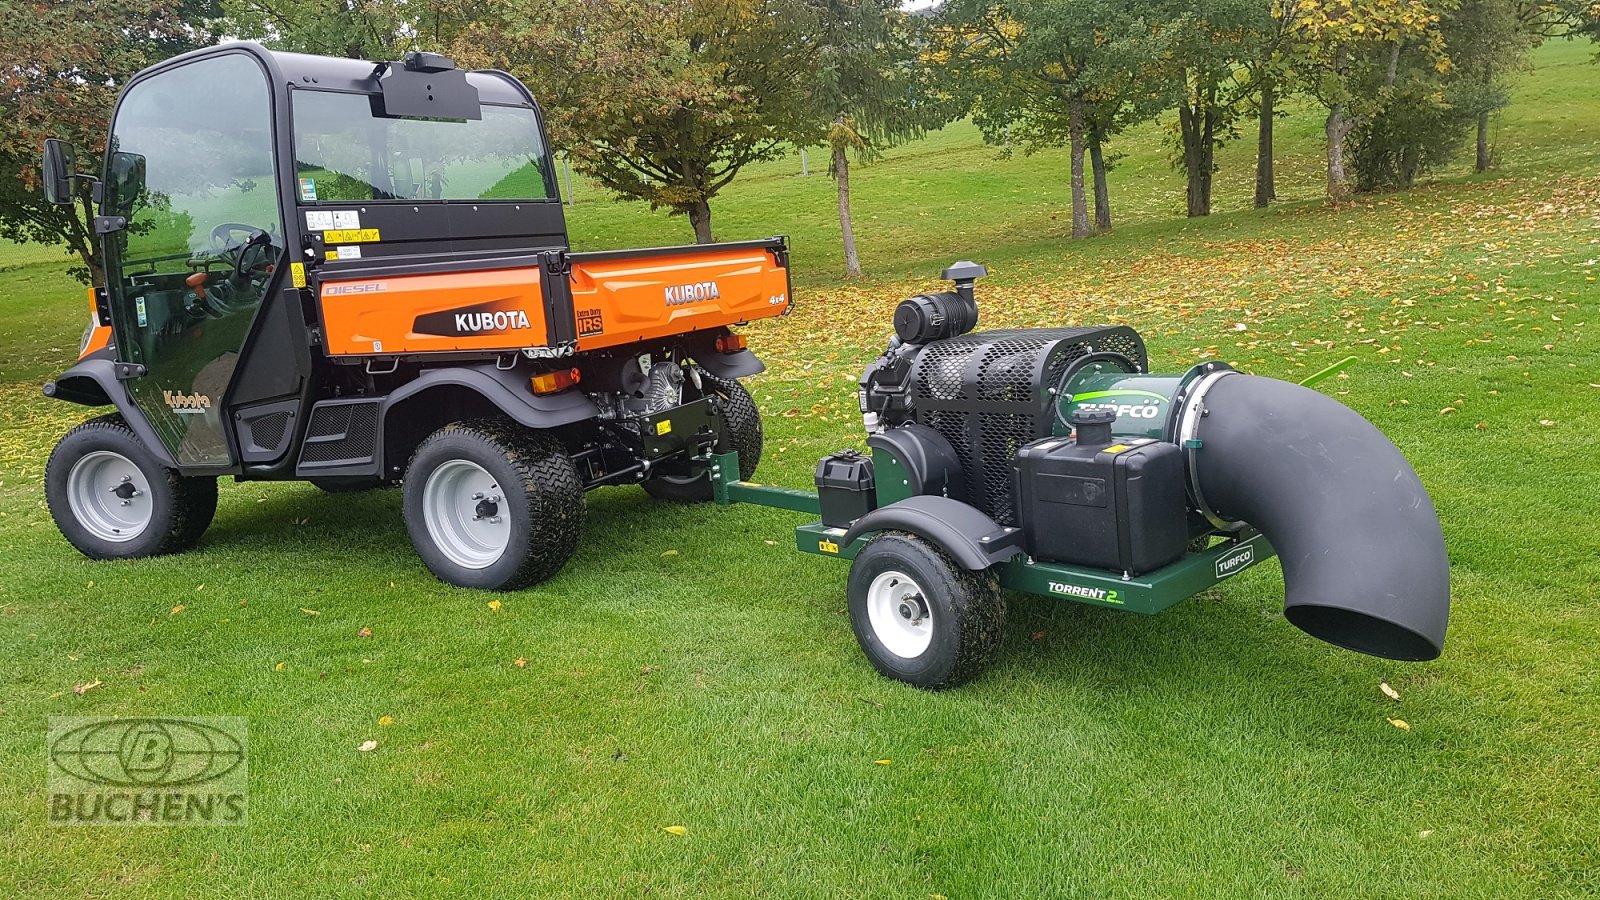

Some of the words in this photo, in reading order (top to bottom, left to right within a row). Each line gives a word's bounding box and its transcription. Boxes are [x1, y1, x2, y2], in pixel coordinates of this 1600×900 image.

[325, 283, 386, 295] DIESEL
[664, 281, 720, 306] KUBOTA
[769, 293, 785, 305] 4x4
[455, 310, 531, 332] KUBOTA
[578, 317, 602, 333] IRS
[163, 390, 211, 408] Kubota
[1218, 550, 1251, 572] TURFCO
[1048, 582, 1106, 600] TORRENT
[1106, 590, 1118, 603] 2
